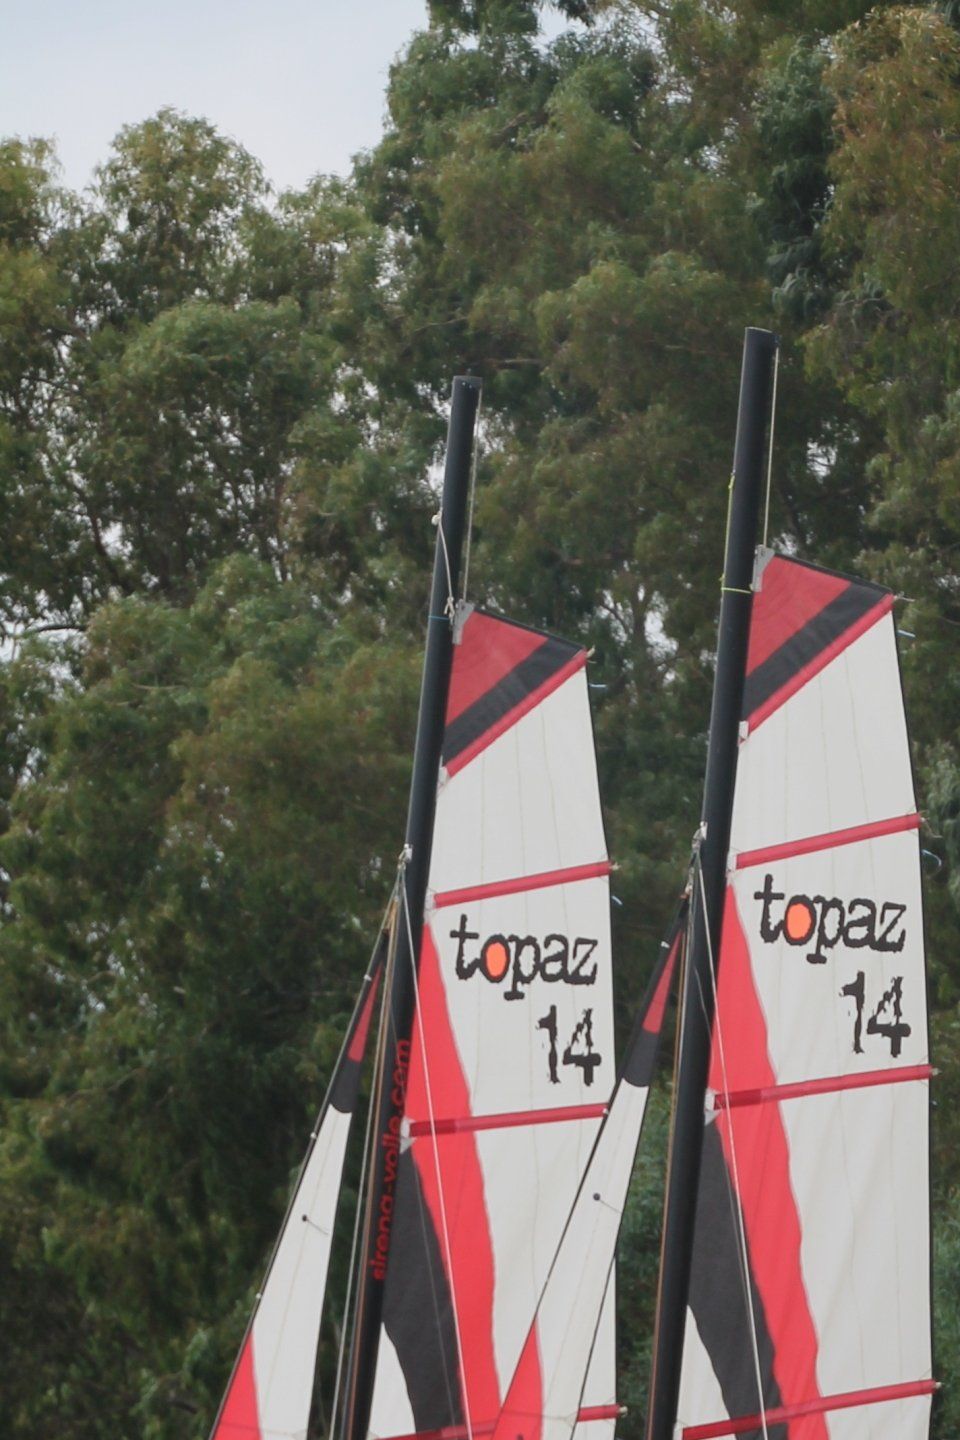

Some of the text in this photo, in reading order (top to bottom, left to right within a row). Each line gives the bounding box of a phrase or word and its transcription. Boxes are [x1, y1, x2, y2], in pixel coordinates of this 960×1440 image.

[450, 914, 598, 1001] topaz
[754, 874, 907, 964] topaz
[536, 1005, 601, 1087] 14
[839, 971, 911, 1058] 14
